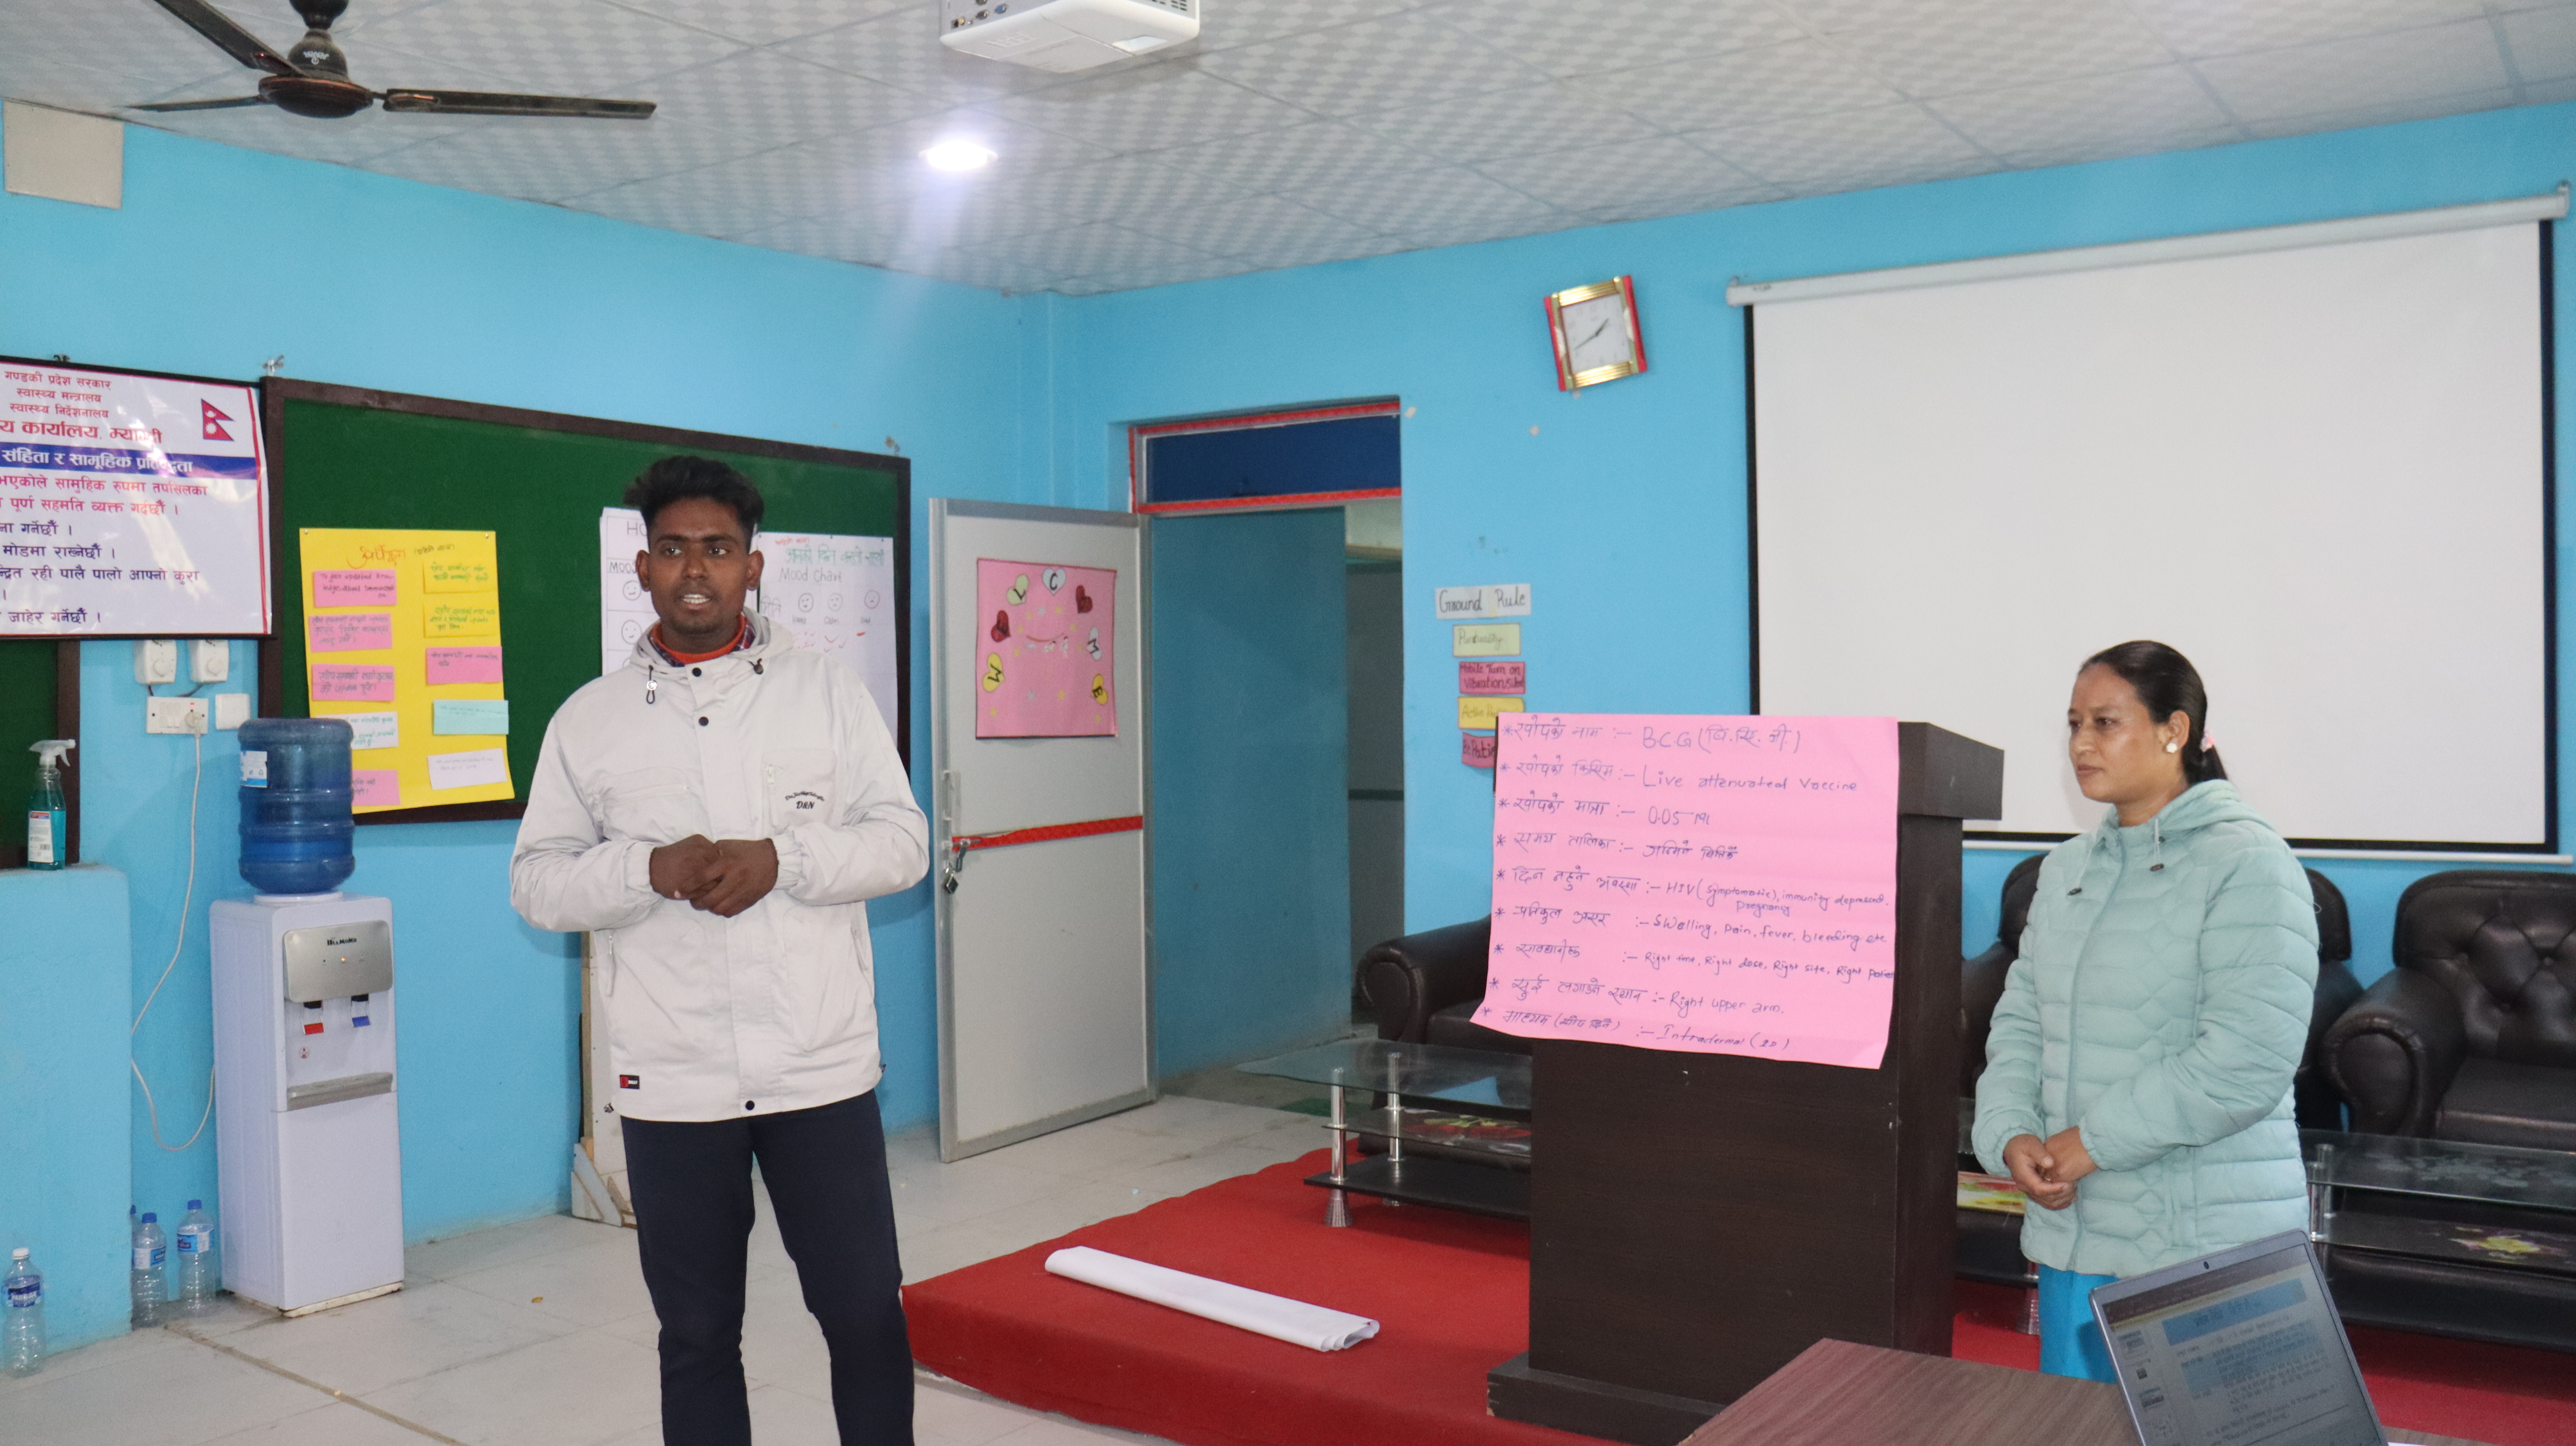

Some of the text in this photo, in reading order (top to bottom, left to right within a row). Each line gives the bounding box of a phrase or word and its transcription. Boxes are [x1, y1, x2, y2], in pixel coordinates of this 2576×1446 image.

[5, 371, 111, 390] गण्डकी प्रदेश सरकार
[17, 388, 102, 403] स्वास्थ्य मन्त्रालय
[10, 403, 109, 418] स्वास्थ्य निर्देशनालय
[1, 447, 50, 464] संहिता
[54, 453, 65, 465] र
[70, 452, 132, 471] सामूहिक
[55, 475, 106, 494] सामुहिक
[10, 495, 35, 512] पूर्ण
[41, 497, 85, 512] सहमति
[91, 501, 125, 513] व्यक्त
[3, 543, 46, 557] मोडमा
[30, 565, 53, 581] रही
[60, 565, 86, 580] पालै
[92, 567, 122, 581] पालो
[130, 567, 167, 580] आफ्नो
[174, 571, 200, 585] कुरा
[778, 565, 841, 582] Mood Chart
[1495, 586, 1525, 608] Rule
[8, 609, 44, 624] जाहेर
[1572, 726, 1603, 739] नाम
[1643, 764, 1683, 787] Live
[1698, 773, 1788, 790] attenuated
[796, 801, 815, 809] D&N
[1574, 800, 1610, 815] मात्रा
[1514, 832, 1557, 853] समय
[1568, 832, 1616, 850] तालिका
[1512, 866, 1546, 883] दिन
[1553, 865, 1590, 890] नहुने
[1573, 911, 1610, 927] असर
[1802, 930, 1861, 952] bleeding
[1644, 951, 1671, 970] Right
[1704, 956, 1732, 975] Right
[1773, 960, 1799, 979] Right
[1836, 966, 1862, 984] Right
[1608, 987, 1648, 1005] स्थान
[1670, 990, 1704, 1018] Right
